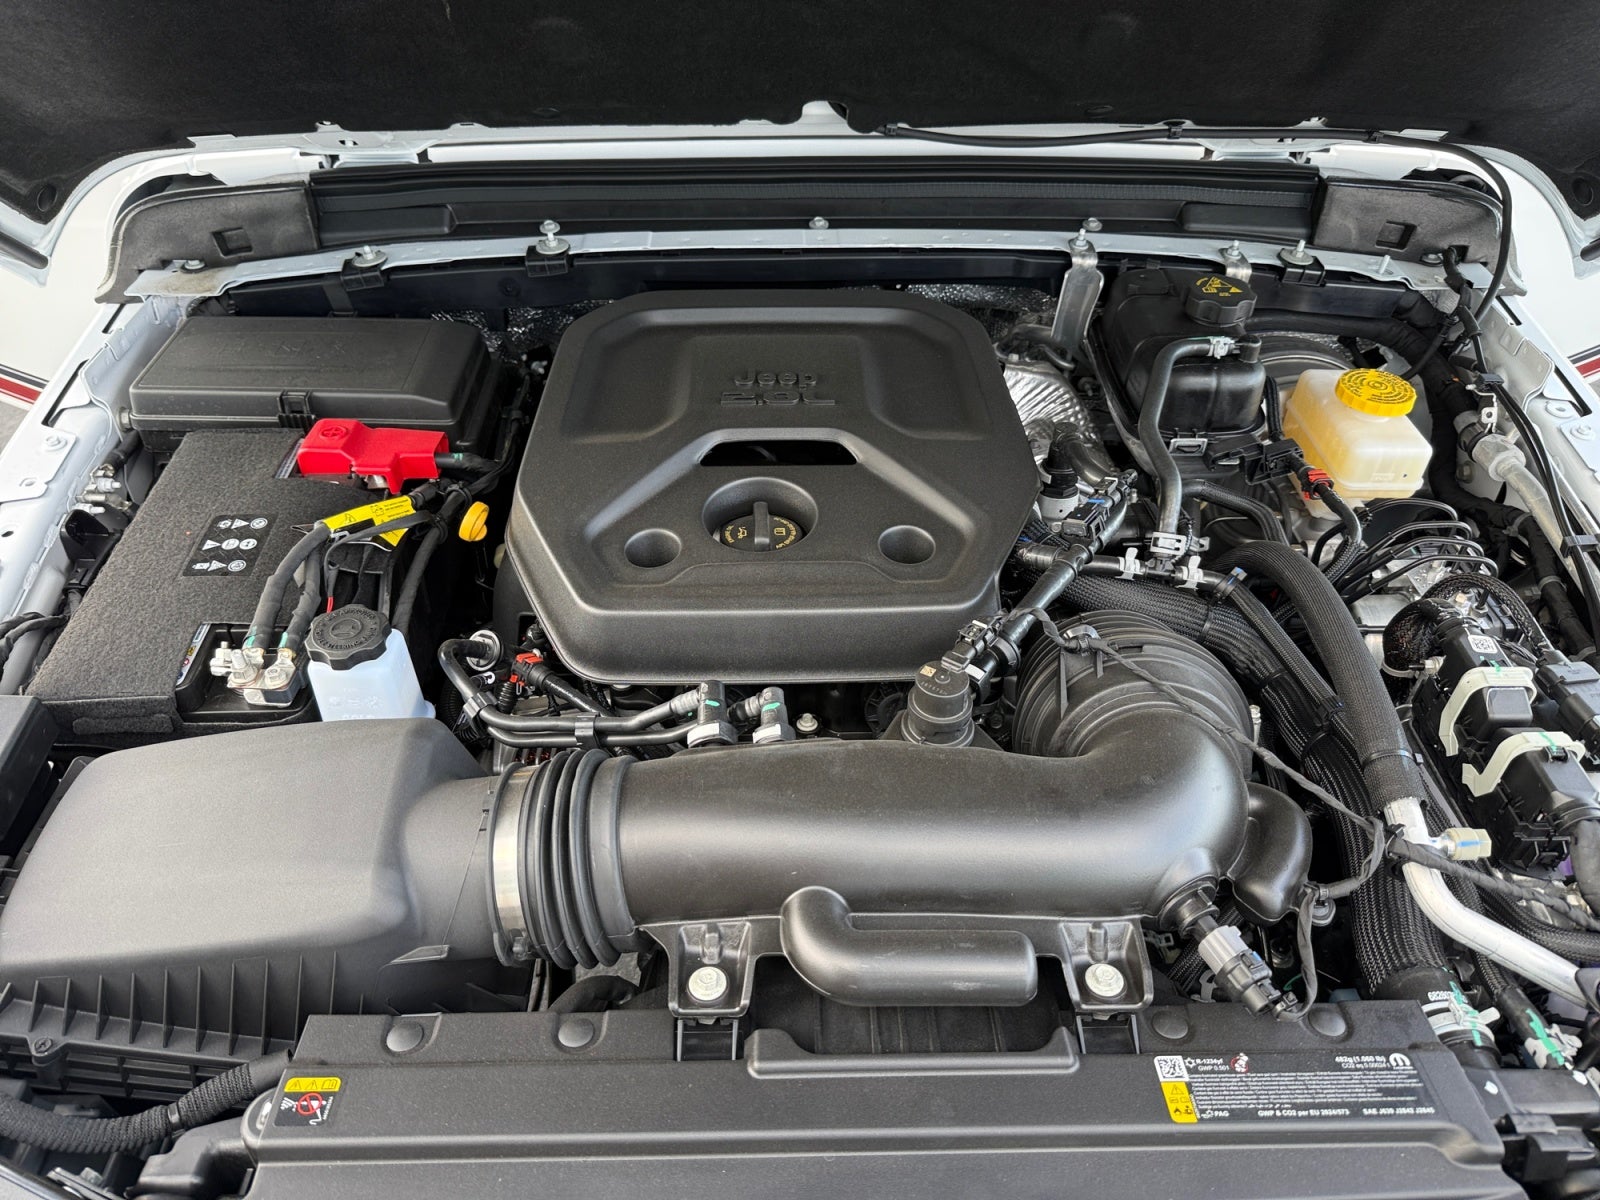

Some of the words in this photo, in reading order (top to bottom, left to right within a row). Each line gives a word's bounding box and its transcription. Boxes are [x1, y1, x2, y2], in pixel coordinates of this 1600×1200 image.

[734, 370, 817, 390] Jeep
[720, 391, 836, 406] 2.0L
[1214, 1110, 1230, 1118] PAG
[1257, 1109, 1275, 1118] GWP
[1275, 1109, 1282, 1117] &
[1282, 1109, 1297, 1117] CO2
[1309, 1109, 1320, 1117] EU
